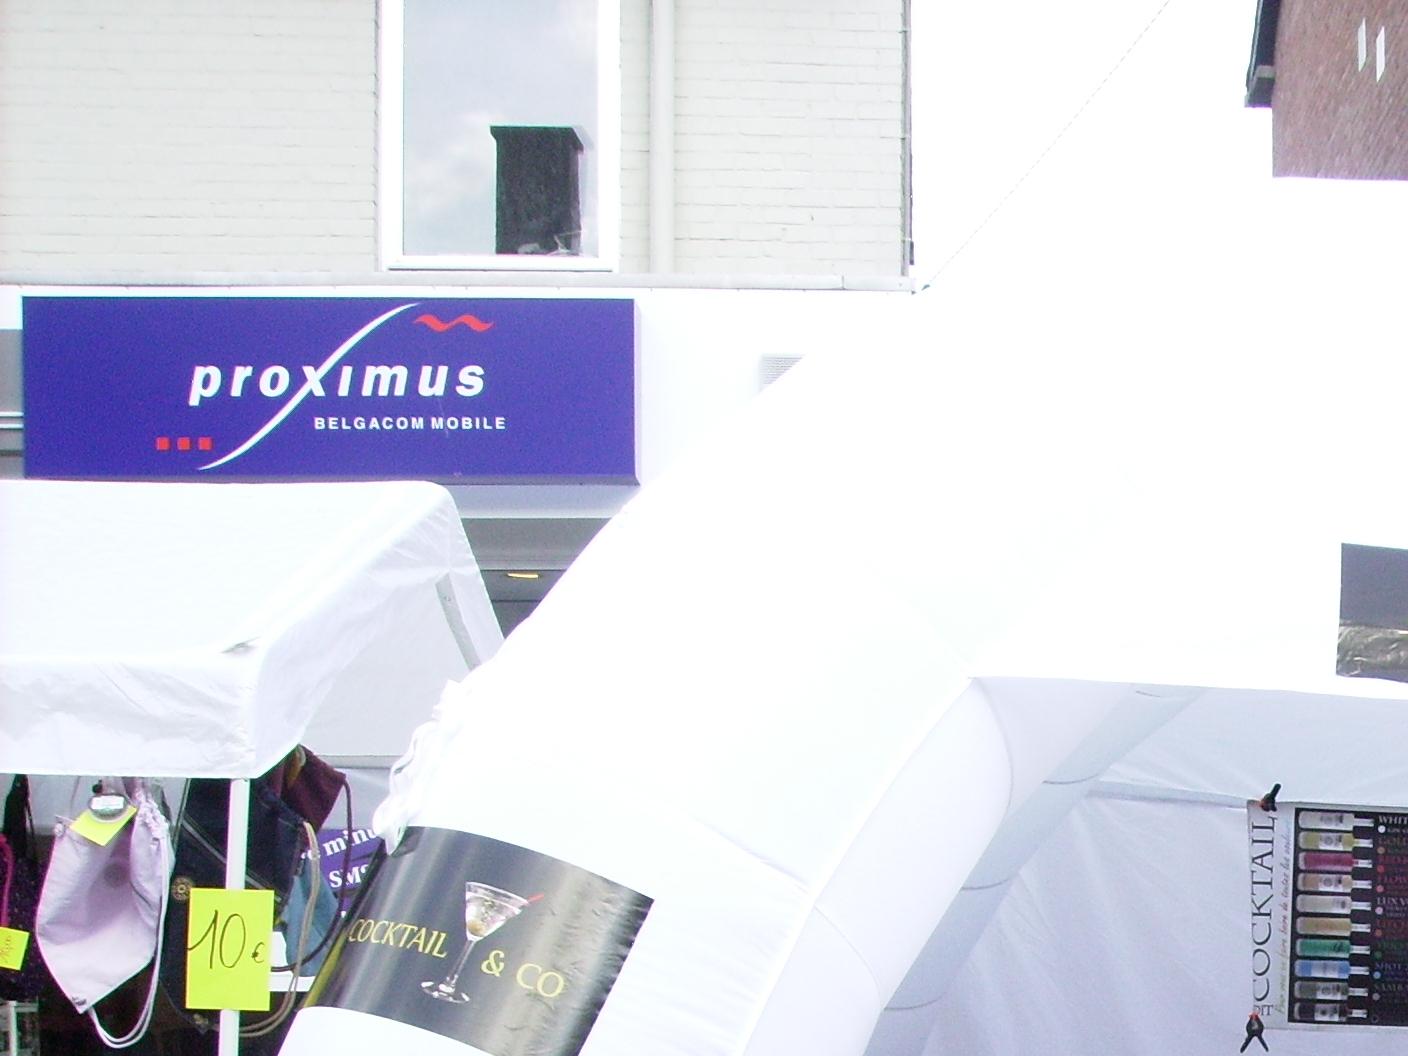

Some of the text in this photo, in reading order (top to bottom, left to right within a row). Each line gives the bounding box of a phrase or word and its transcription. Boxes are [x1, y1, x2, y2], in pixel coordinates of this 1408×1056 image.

[189, 362, 487, 406] proximus
[314, 416, 507, 430] BELGACOM MOBILE
[1252, 815, 1278, 1002] COCKTAIL
[188, 909, 265, 969] 10 €
[348, 918, 565, 998] COCKTAIL & CO
